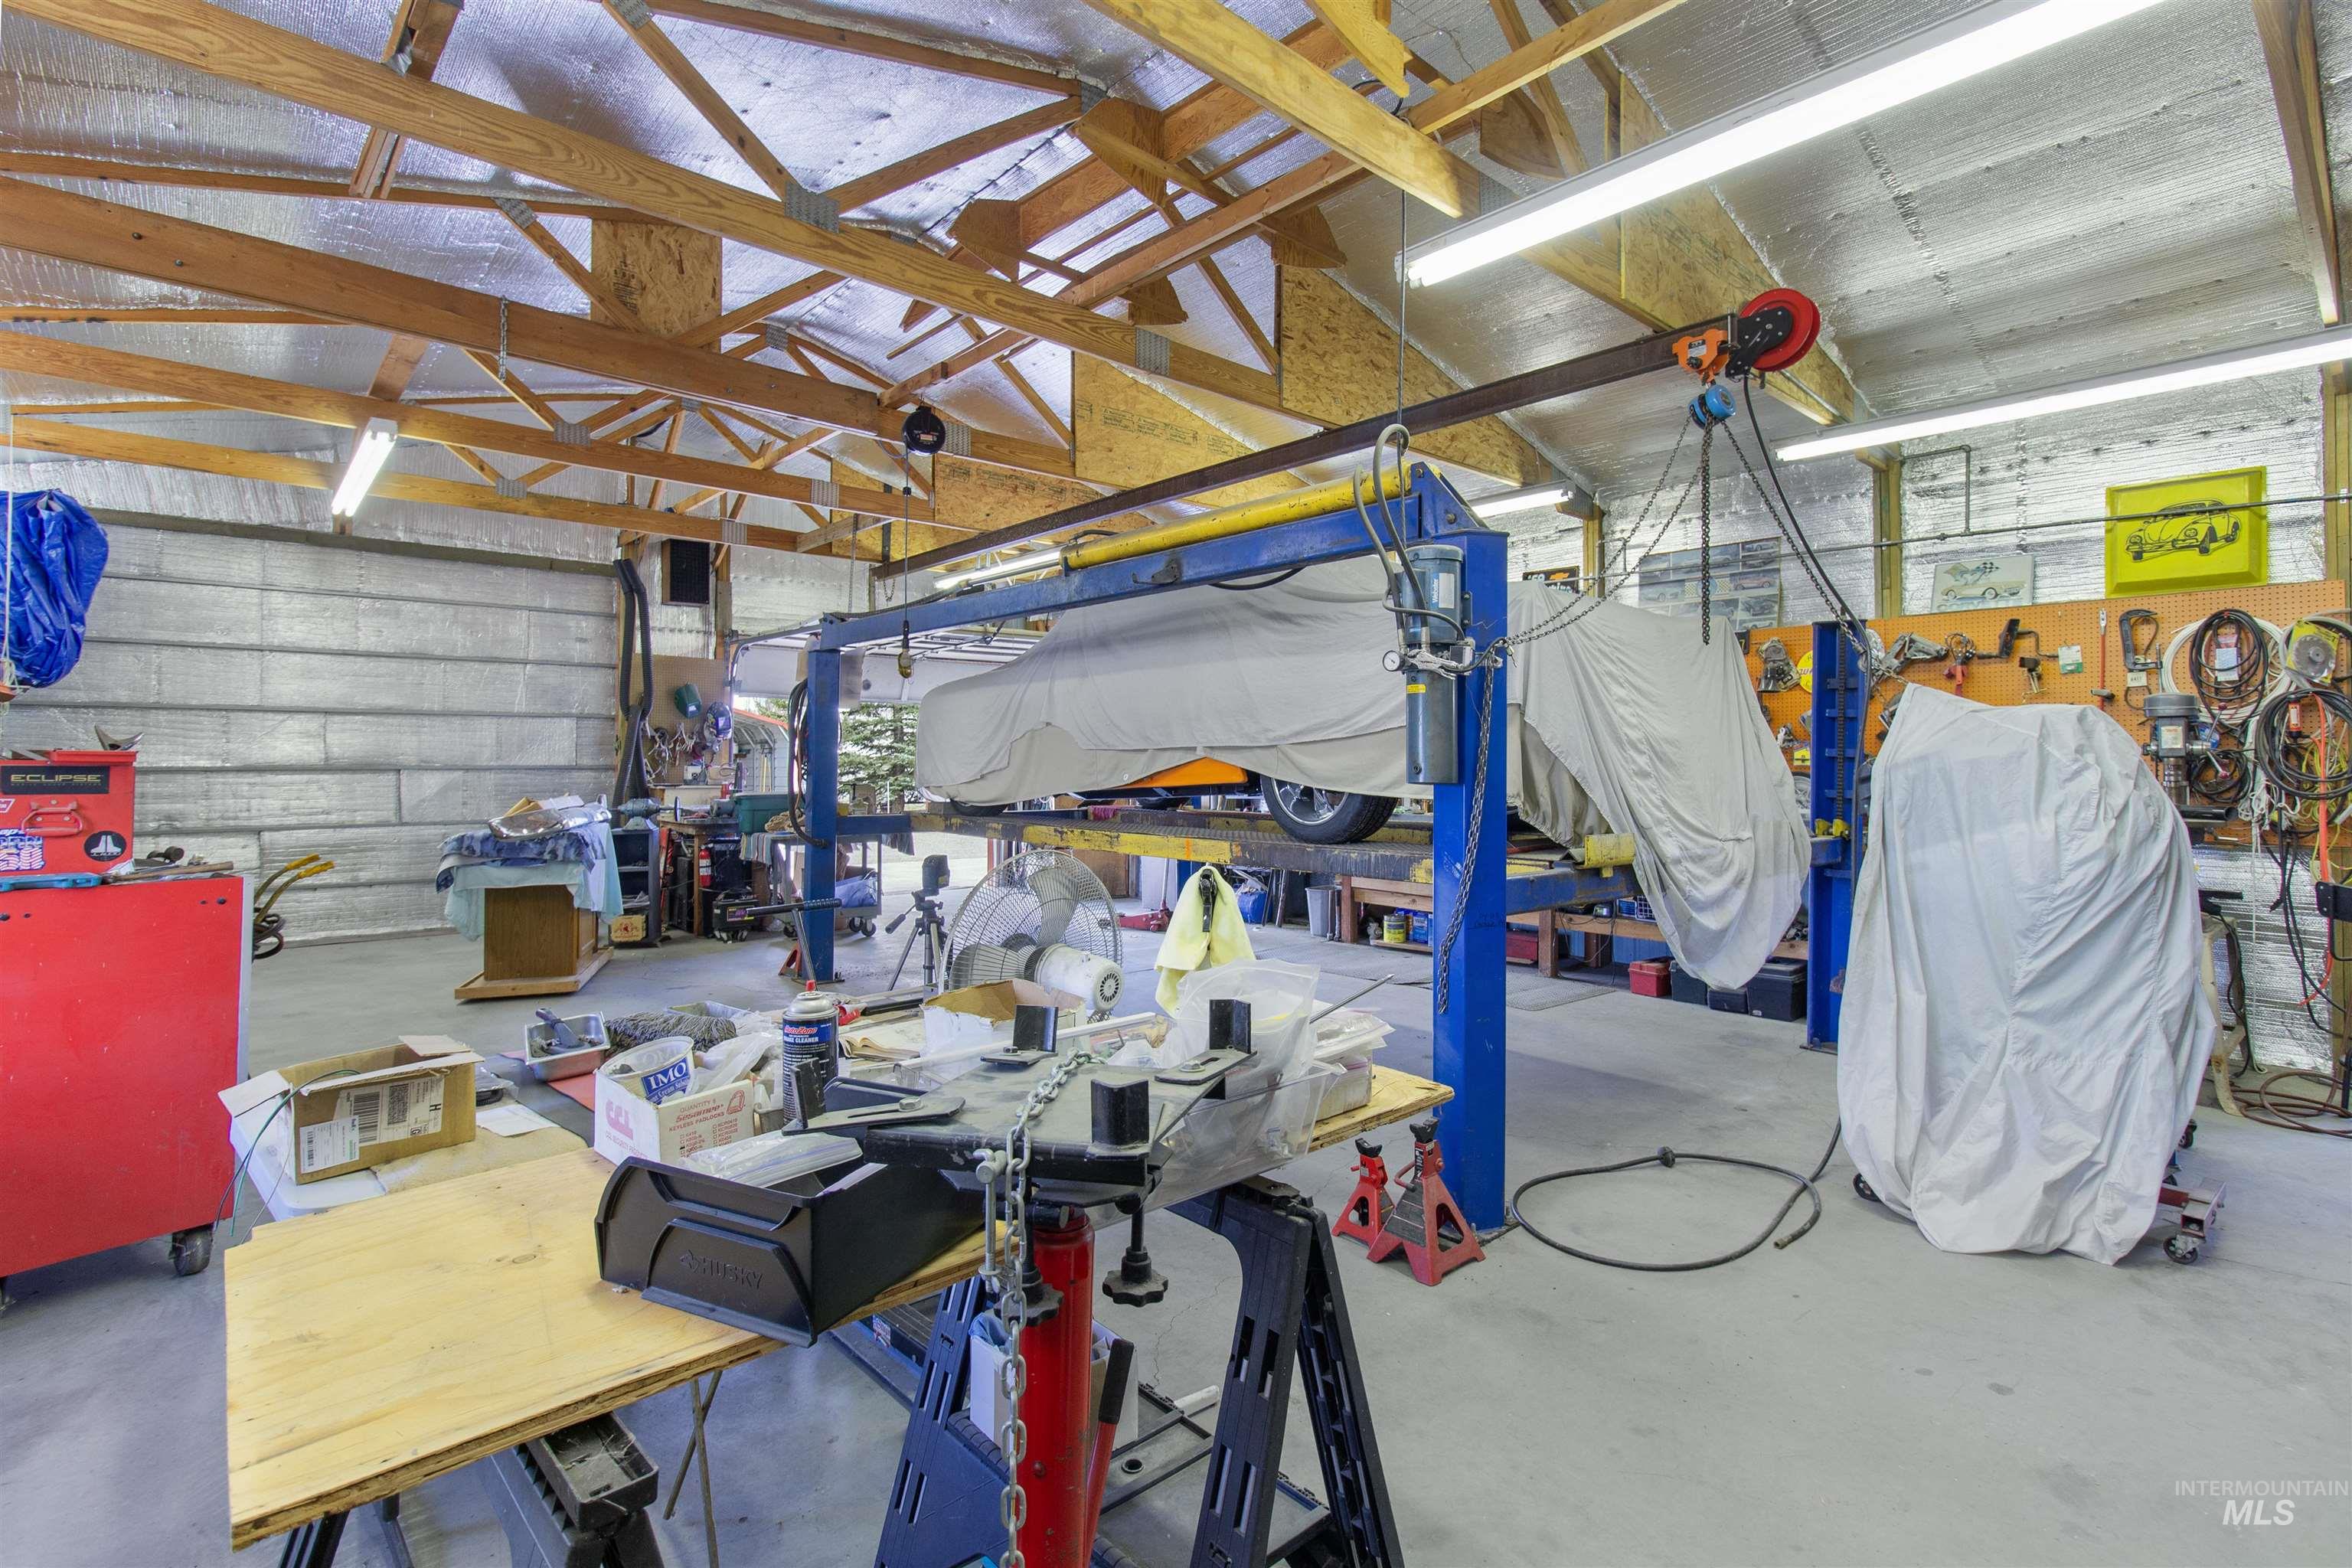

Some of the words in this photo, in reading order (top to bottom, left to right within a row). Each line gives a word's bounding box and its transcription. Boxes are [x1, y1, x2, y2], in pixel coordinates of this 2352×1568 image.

[647, 1063, 687, 1089] IMO
[680, 1099, 710, 1113] QUANTITY
[668, 1120, 694, 1132] KEYLESS
[695, 1111, 725, 1125] PADLOCKS
[702, 1256, 763, 1289] HUSKY
